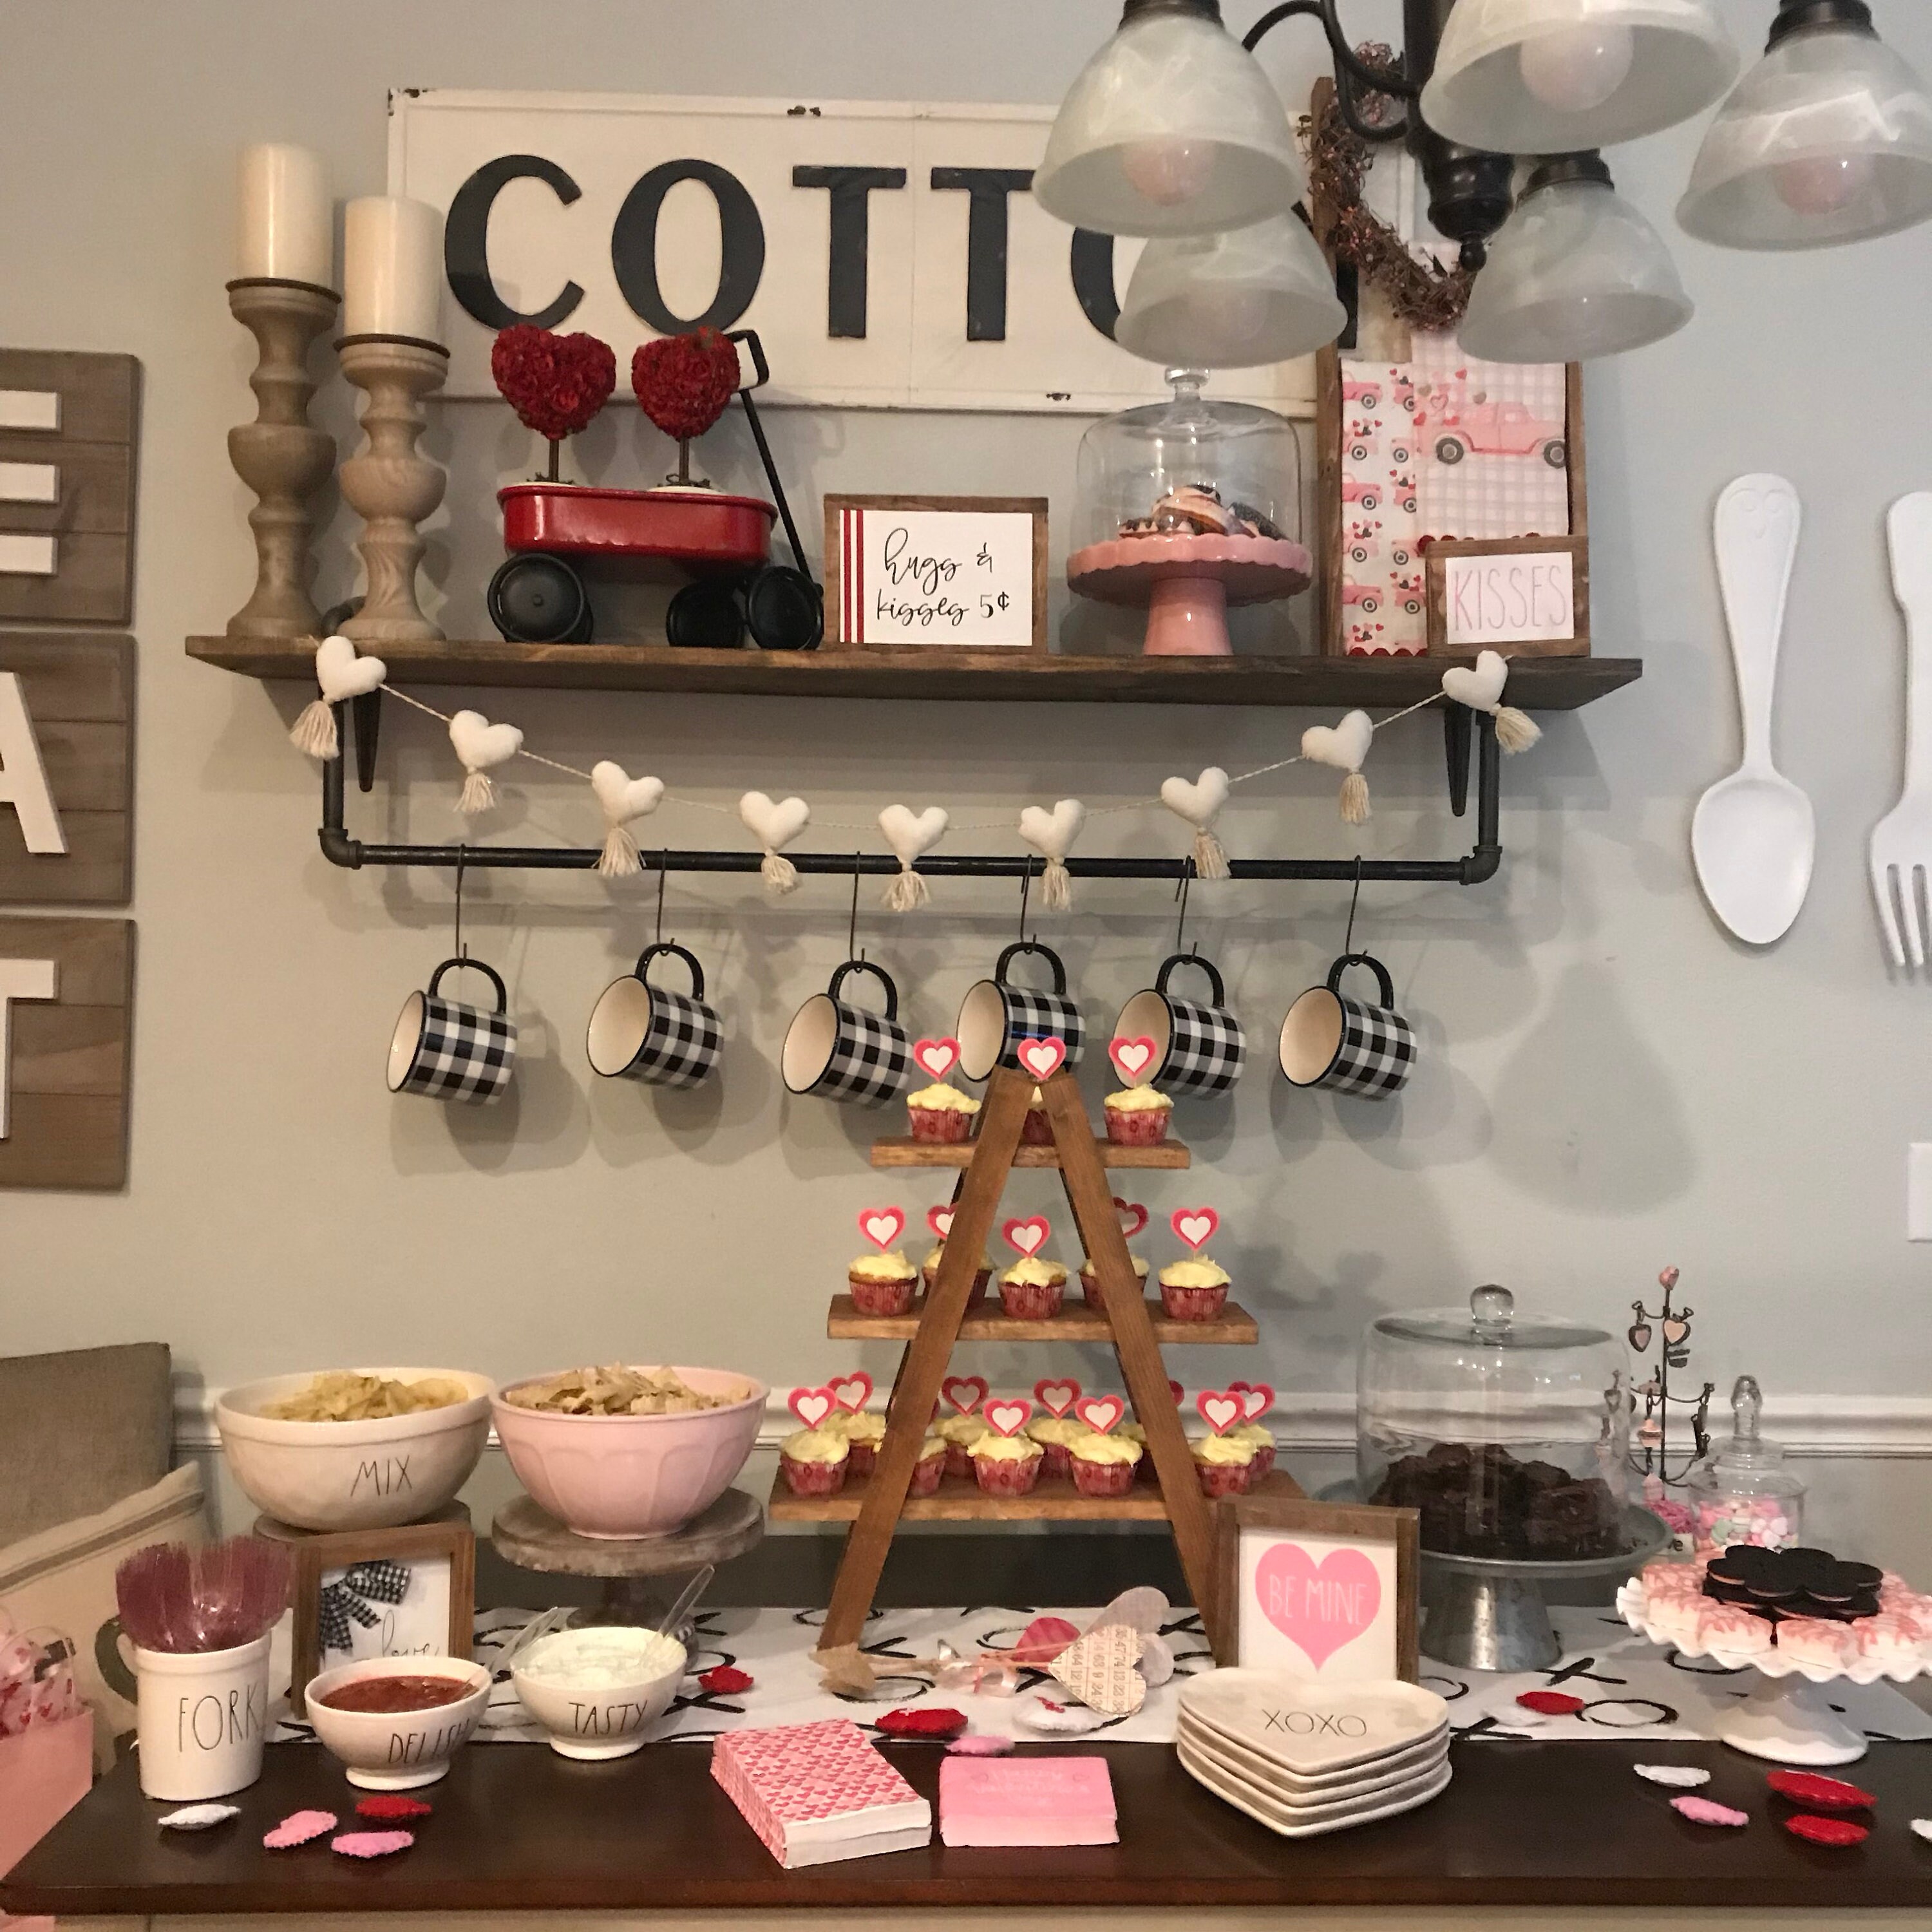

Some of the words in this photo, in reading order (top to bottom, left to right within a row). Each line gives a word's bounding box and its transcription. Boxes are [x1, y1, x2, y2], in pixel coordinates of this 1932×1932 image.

[444, 154, 1358, 349] COTT
[1454, 564, 1567, 631] KISSES
[350, 1454, 413, 1497] MIX
[1269, 1574, 1296, 1618] BE
[1305, 1577, 1368, 1626] MINE
[178, 1682, 260, 1752] FORK
[568, 1700, 648, 1736] TASTY
[1262, 1708, 1367, 1738] XOXO
